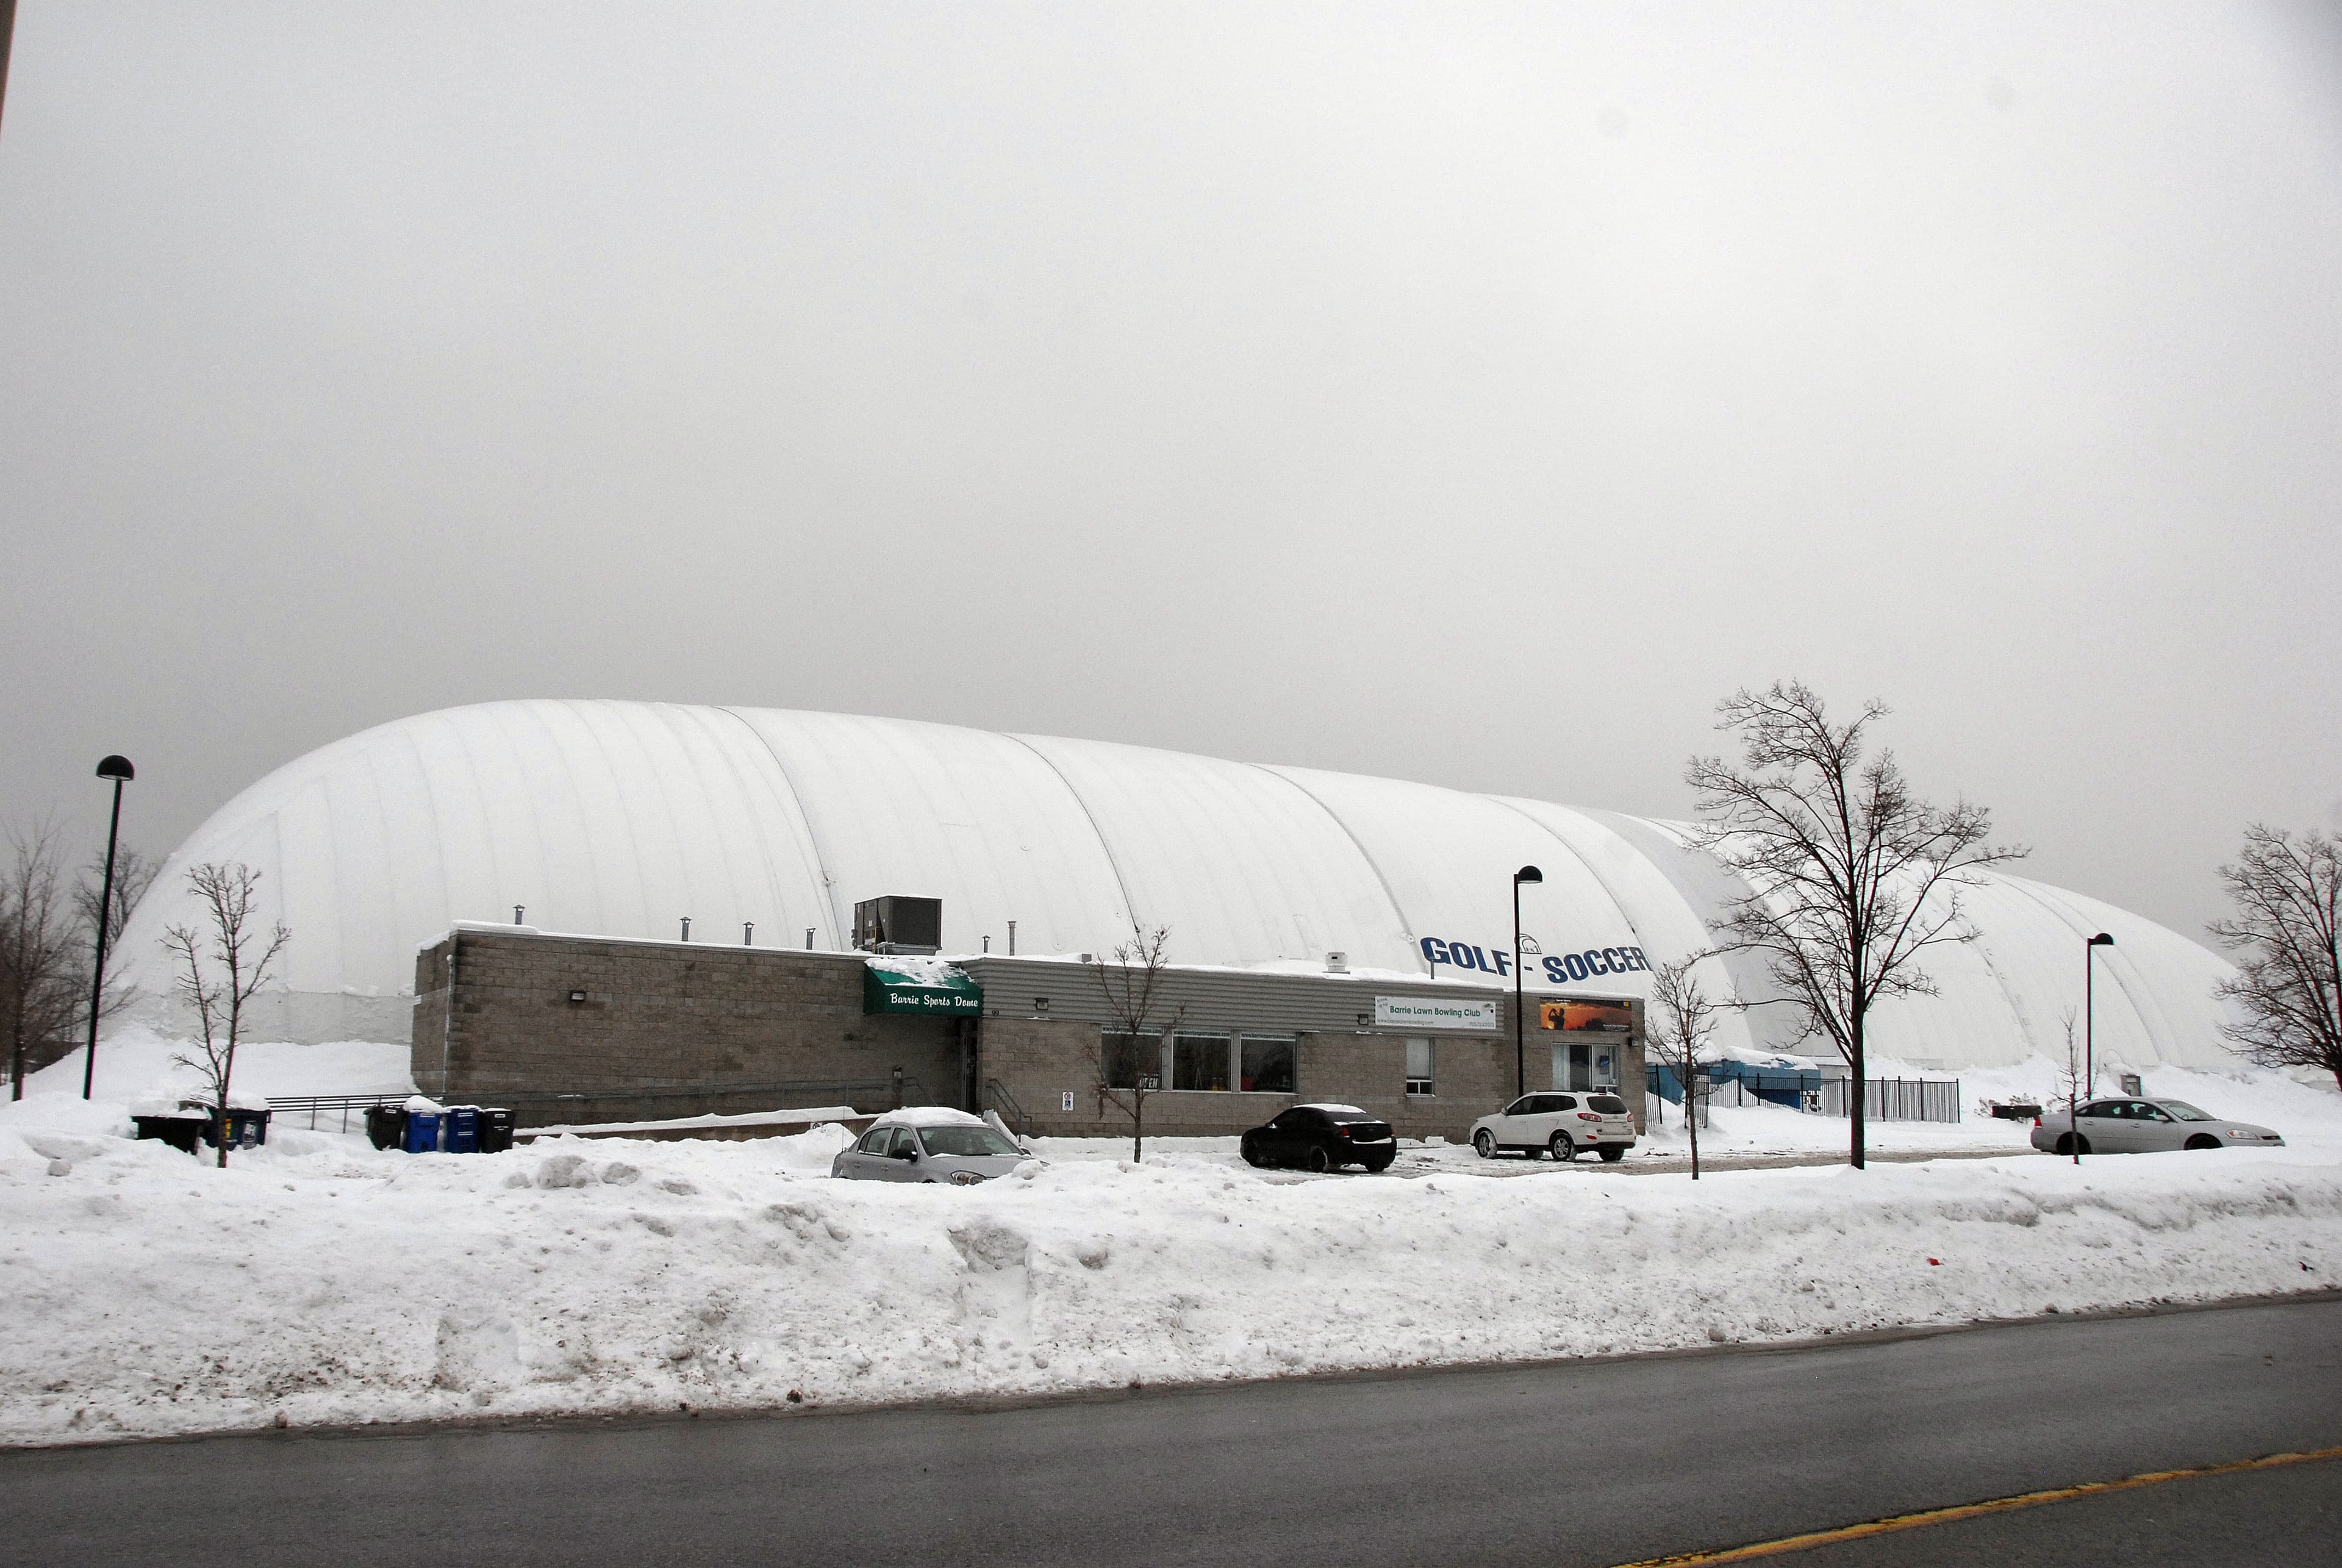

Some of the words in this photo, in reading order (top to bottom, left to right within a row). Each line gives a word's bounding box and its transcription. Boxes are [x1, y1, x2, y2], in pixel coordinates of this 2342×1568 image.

[1420, 937, 1512, 977] GOLF
[1542, 947, 1653, 984] SOCCER
[890, 993, 919, 1005] Barrie
[923, 995, 950, 1008] Sports
[954, 996, 978, 1007] Dome
[1390, 1006, 1412, 1014] Barrie
[1414, 1007, 1433, 1015] Lawn
[1434, 1008, 1462, 1018] Bowling
